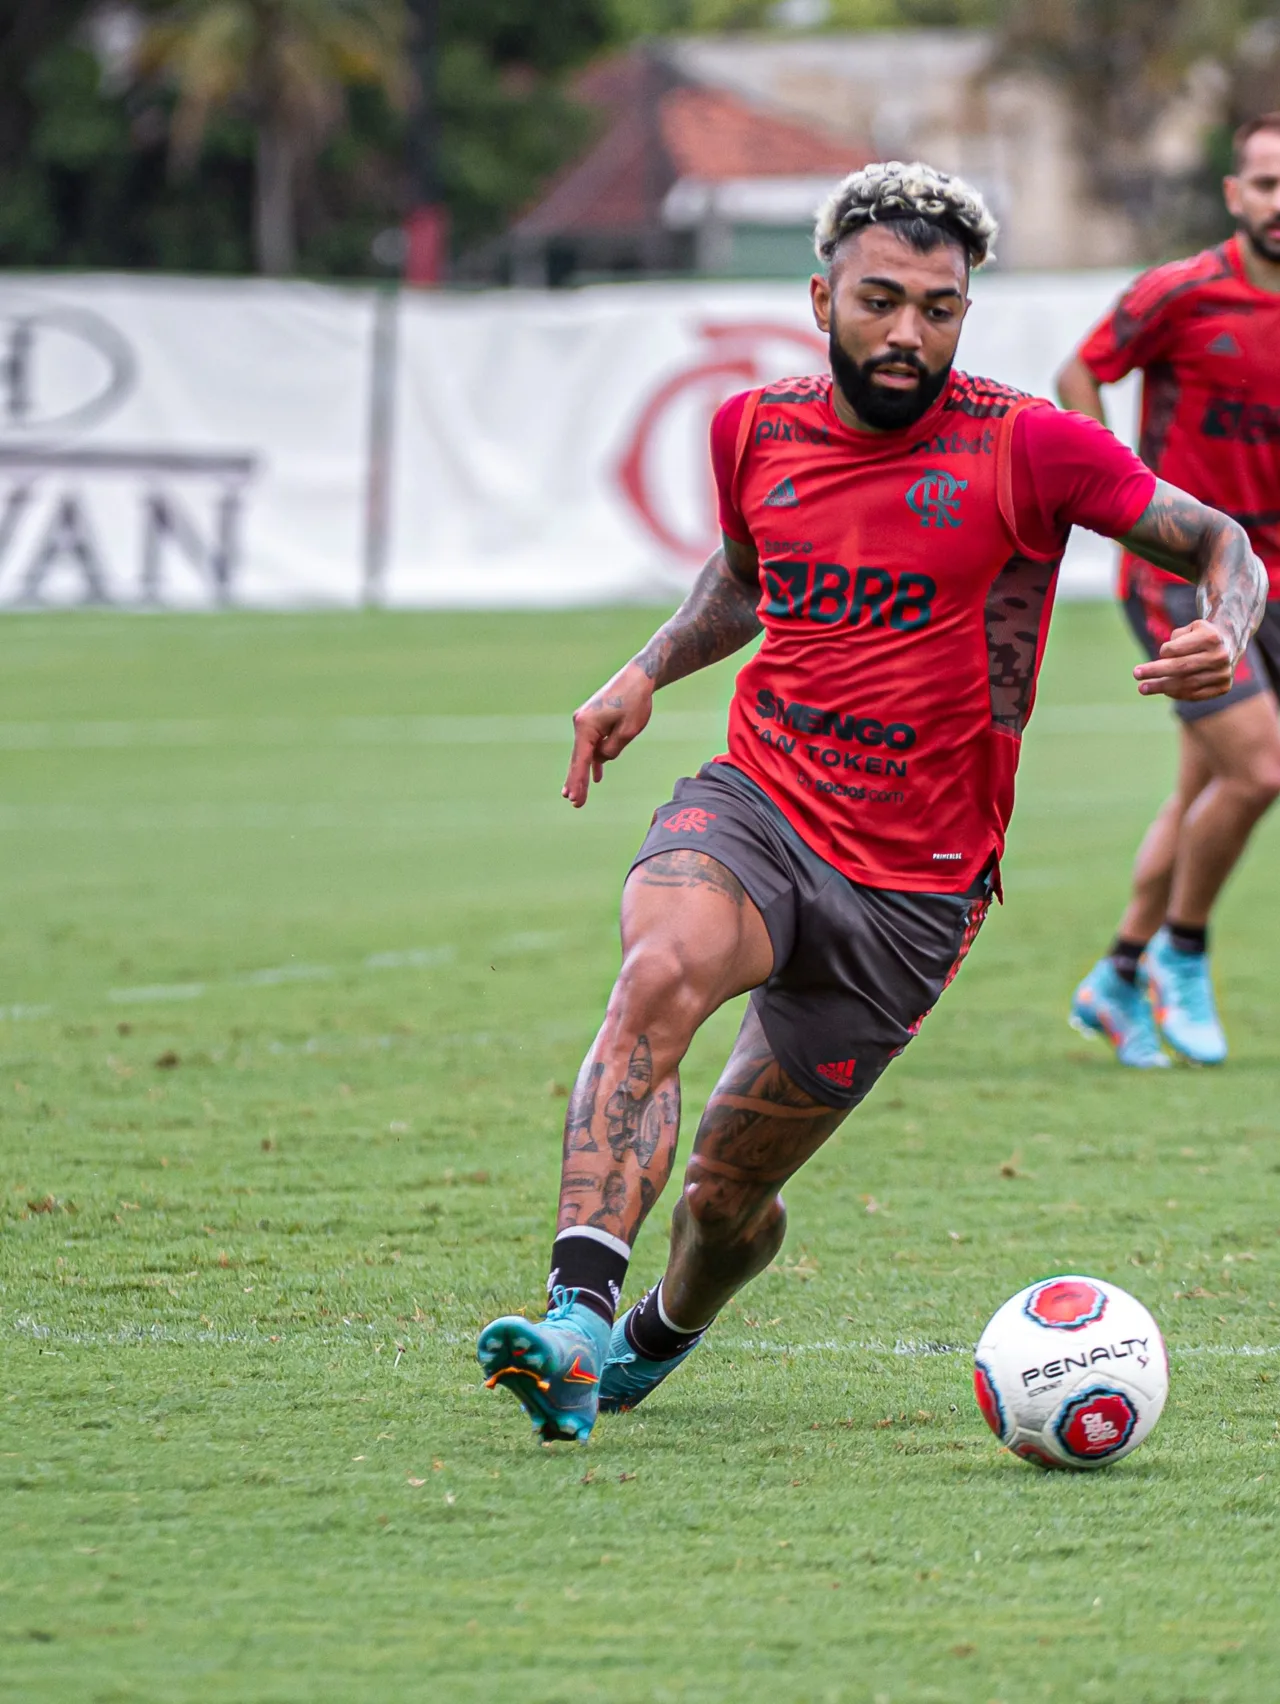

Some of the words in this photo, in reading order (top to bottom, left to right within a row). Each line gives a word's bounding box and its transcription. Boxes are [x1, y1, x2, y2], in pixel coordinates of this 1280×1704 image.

[763, 537, 814, 554] banco
[808, 562, 938, 633] BRB
[804, 744, 909, 777] TOKEN
[1021, 1337, 1149, 1388] PENALTY
